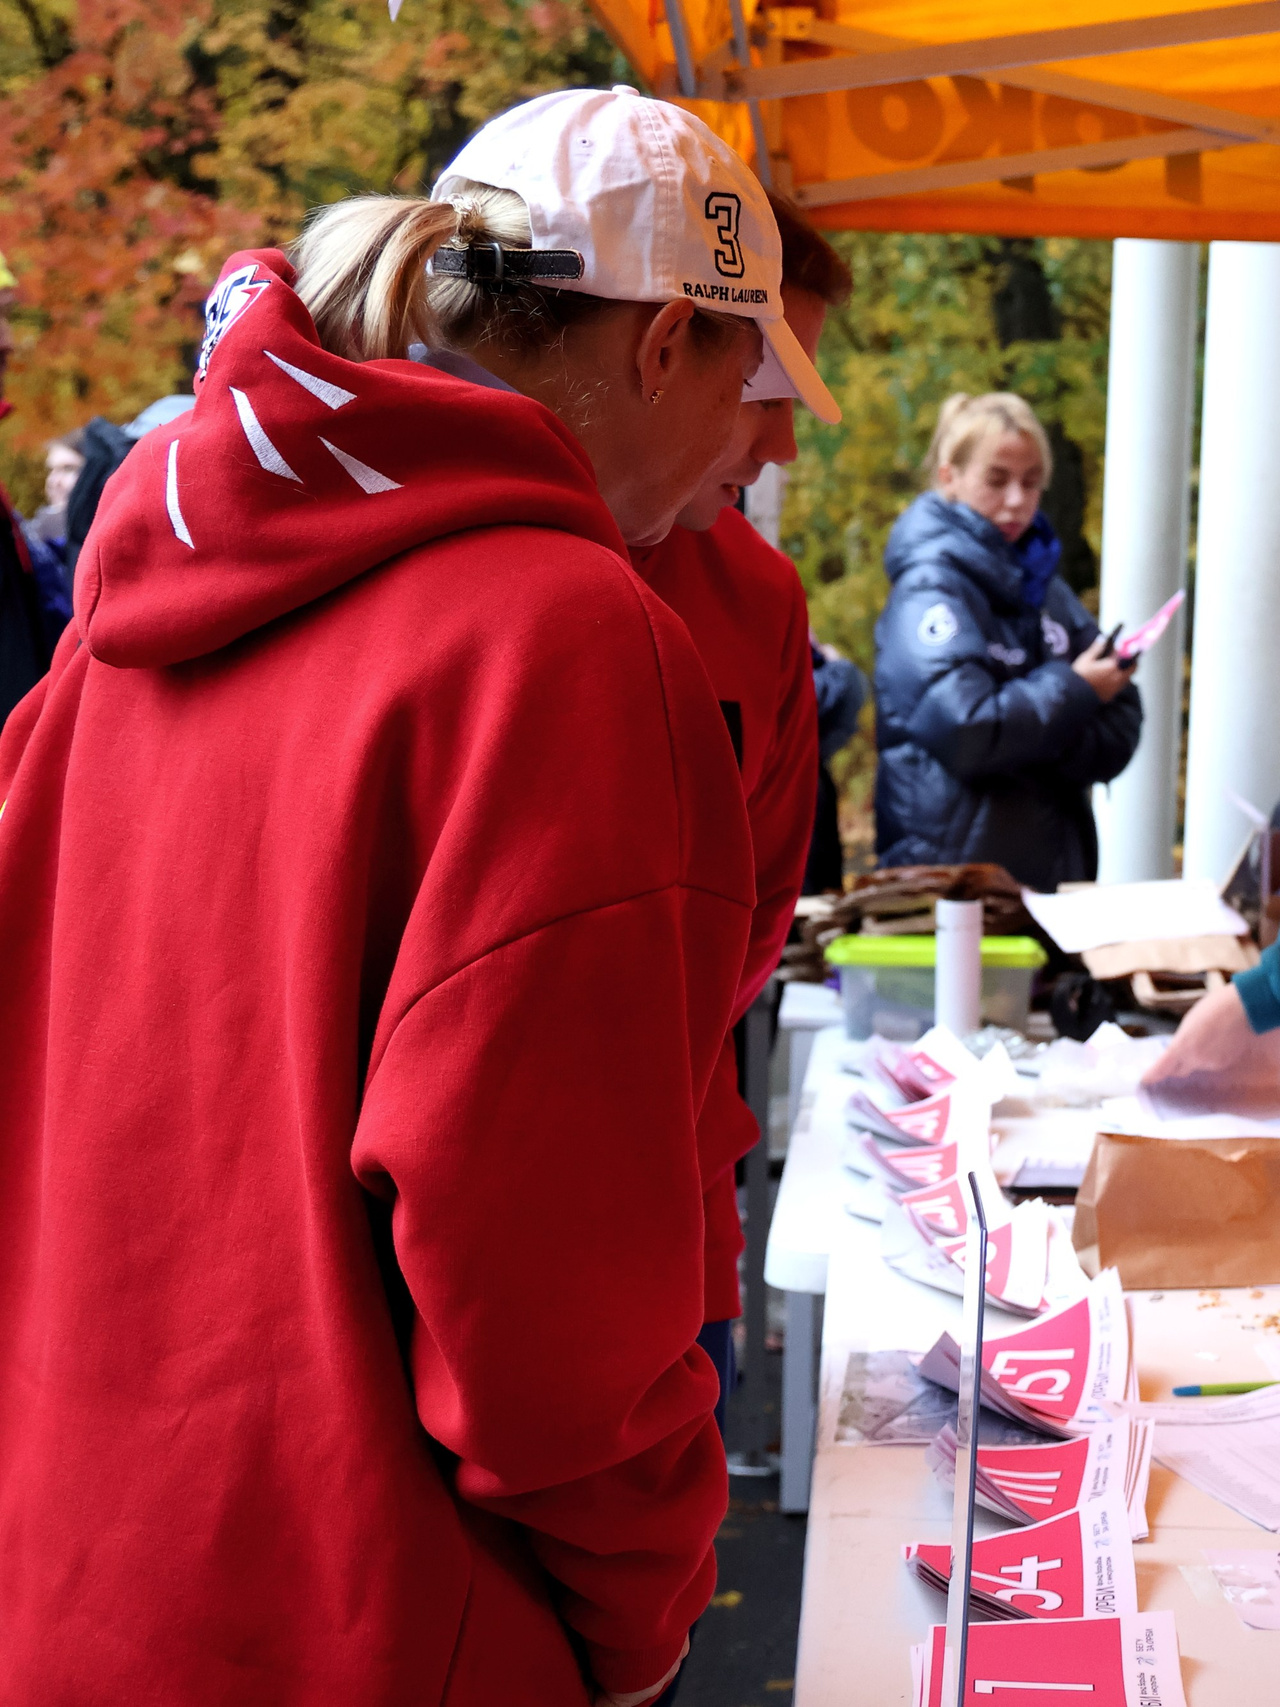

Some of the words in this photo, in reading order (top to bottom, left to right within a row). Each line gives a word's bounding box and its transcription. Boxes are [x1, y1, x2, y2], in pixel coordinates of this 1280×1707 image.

[704, 191, 743, 279] 3
[682, 282, 729, 302] RALPH
[731, 287, 768, 304] LAUREN
[988, 1348, 1075, 1402] 157
[1094, 1584, 1116, 1613] ОРБИ
[973, 1679, 1095, 1695] 1
